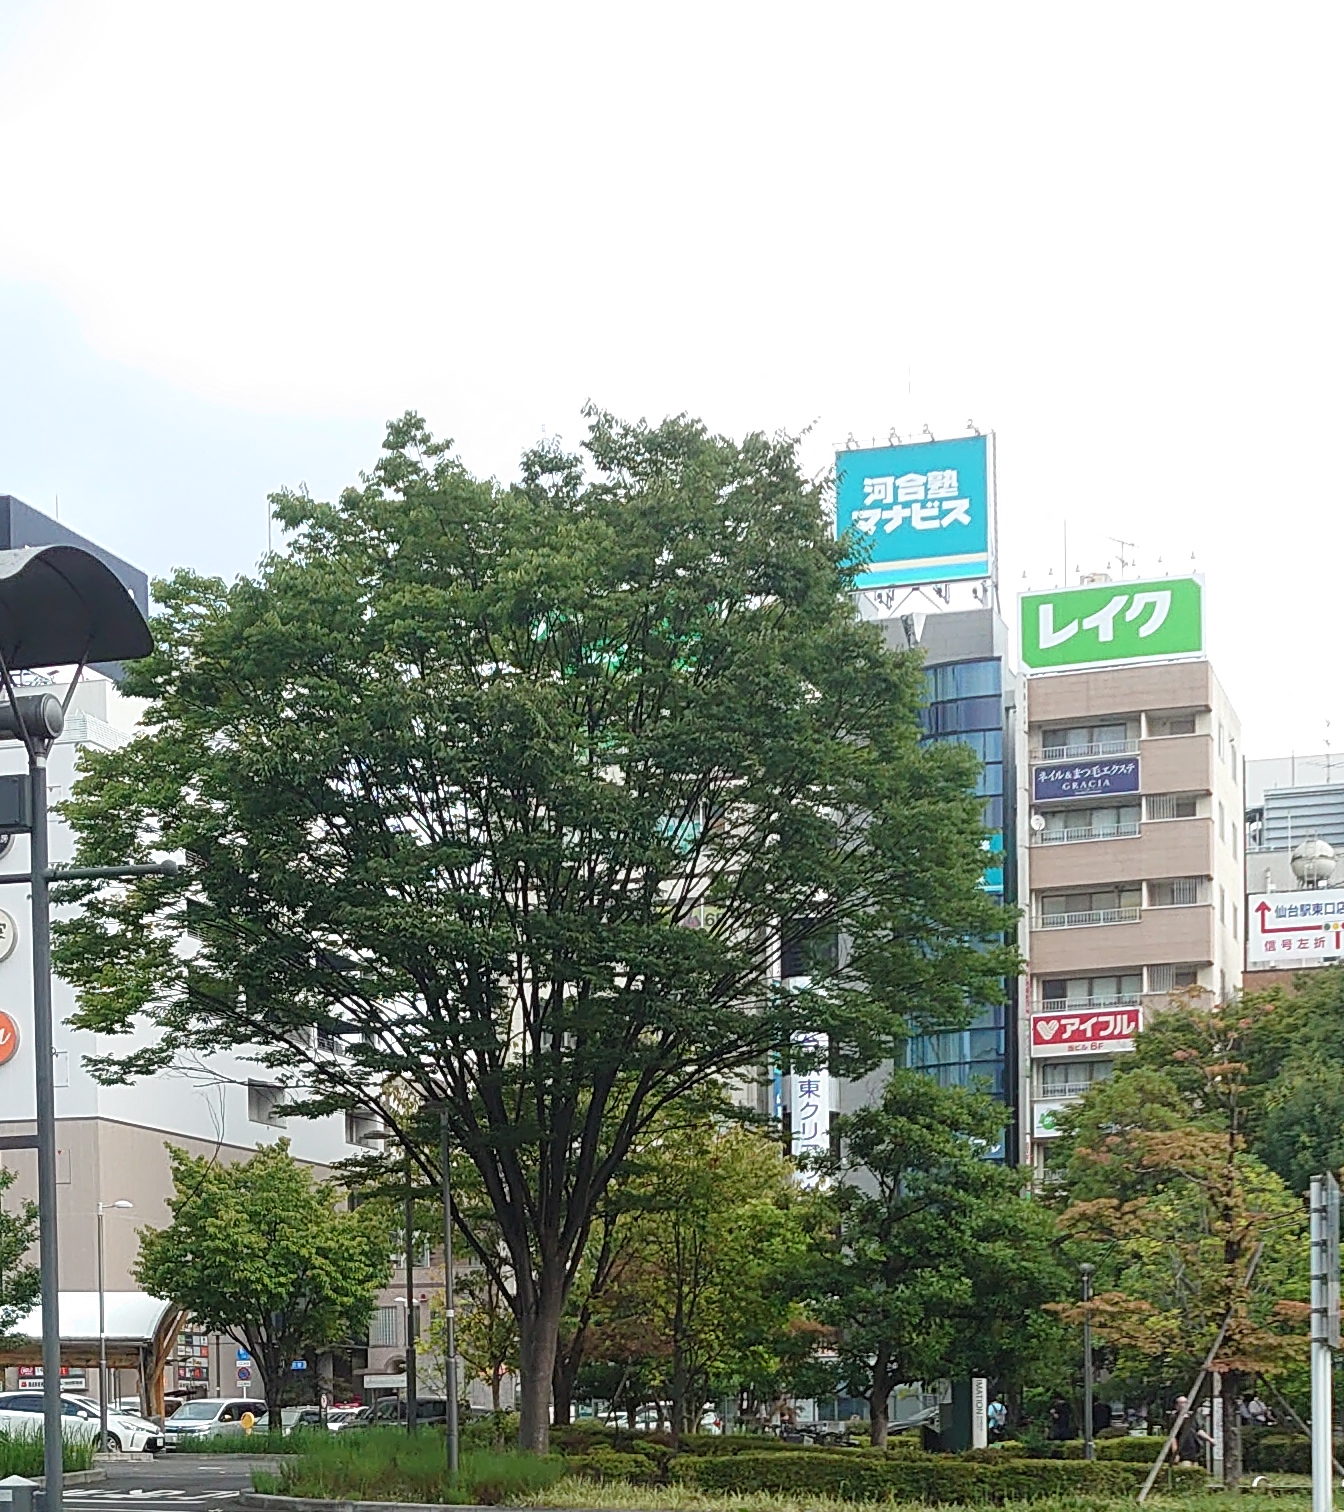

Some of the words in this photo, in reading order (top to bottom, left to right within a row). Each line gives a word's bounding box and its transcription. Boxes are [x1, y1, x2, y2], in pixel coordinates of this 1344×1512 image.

[863, 470, 958, 506] 河合塾
[852, 498, 971, 535] マナビス
[1037, 589, 1171, 650] レイク
[1062, 779, 1110, 790] GRACIA
[1264, 937, 1326, 951] 信号左折
[1061, 1014, 1135, 1039] アイフル
